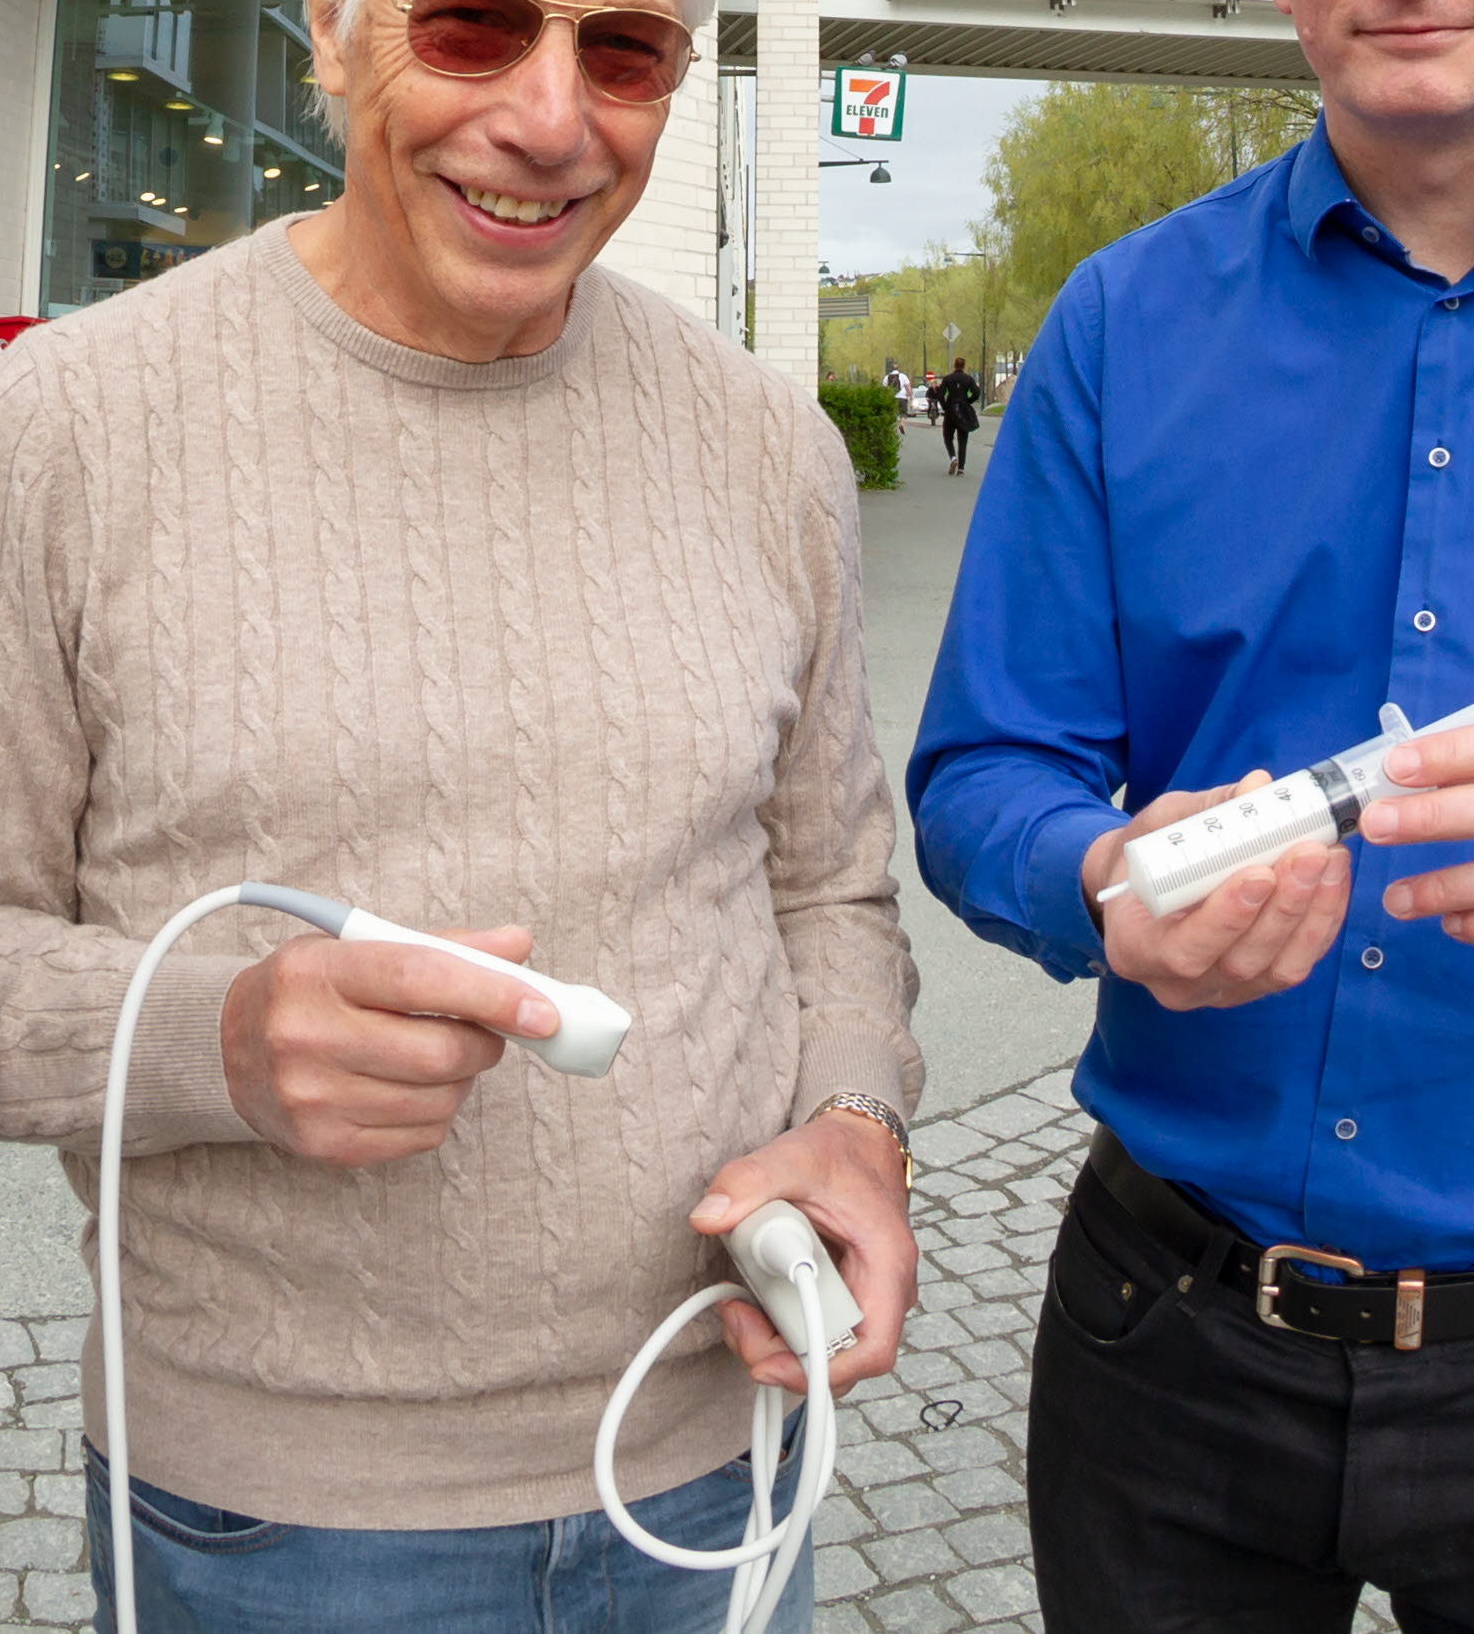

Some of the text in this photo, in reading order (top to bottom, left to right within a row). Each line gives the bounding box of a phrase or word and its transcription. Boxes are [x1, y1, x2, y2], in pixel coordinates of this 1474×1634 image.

[849, 79, 890, 134] 7
[1351, 768, 1366, 781] 60
[1274, 787, 1291, 802] 40
[1239, 802, 1258, 818] 30
[1204, 817, 1223, 832] 20
[1167, 832, 1186, 846] 10
